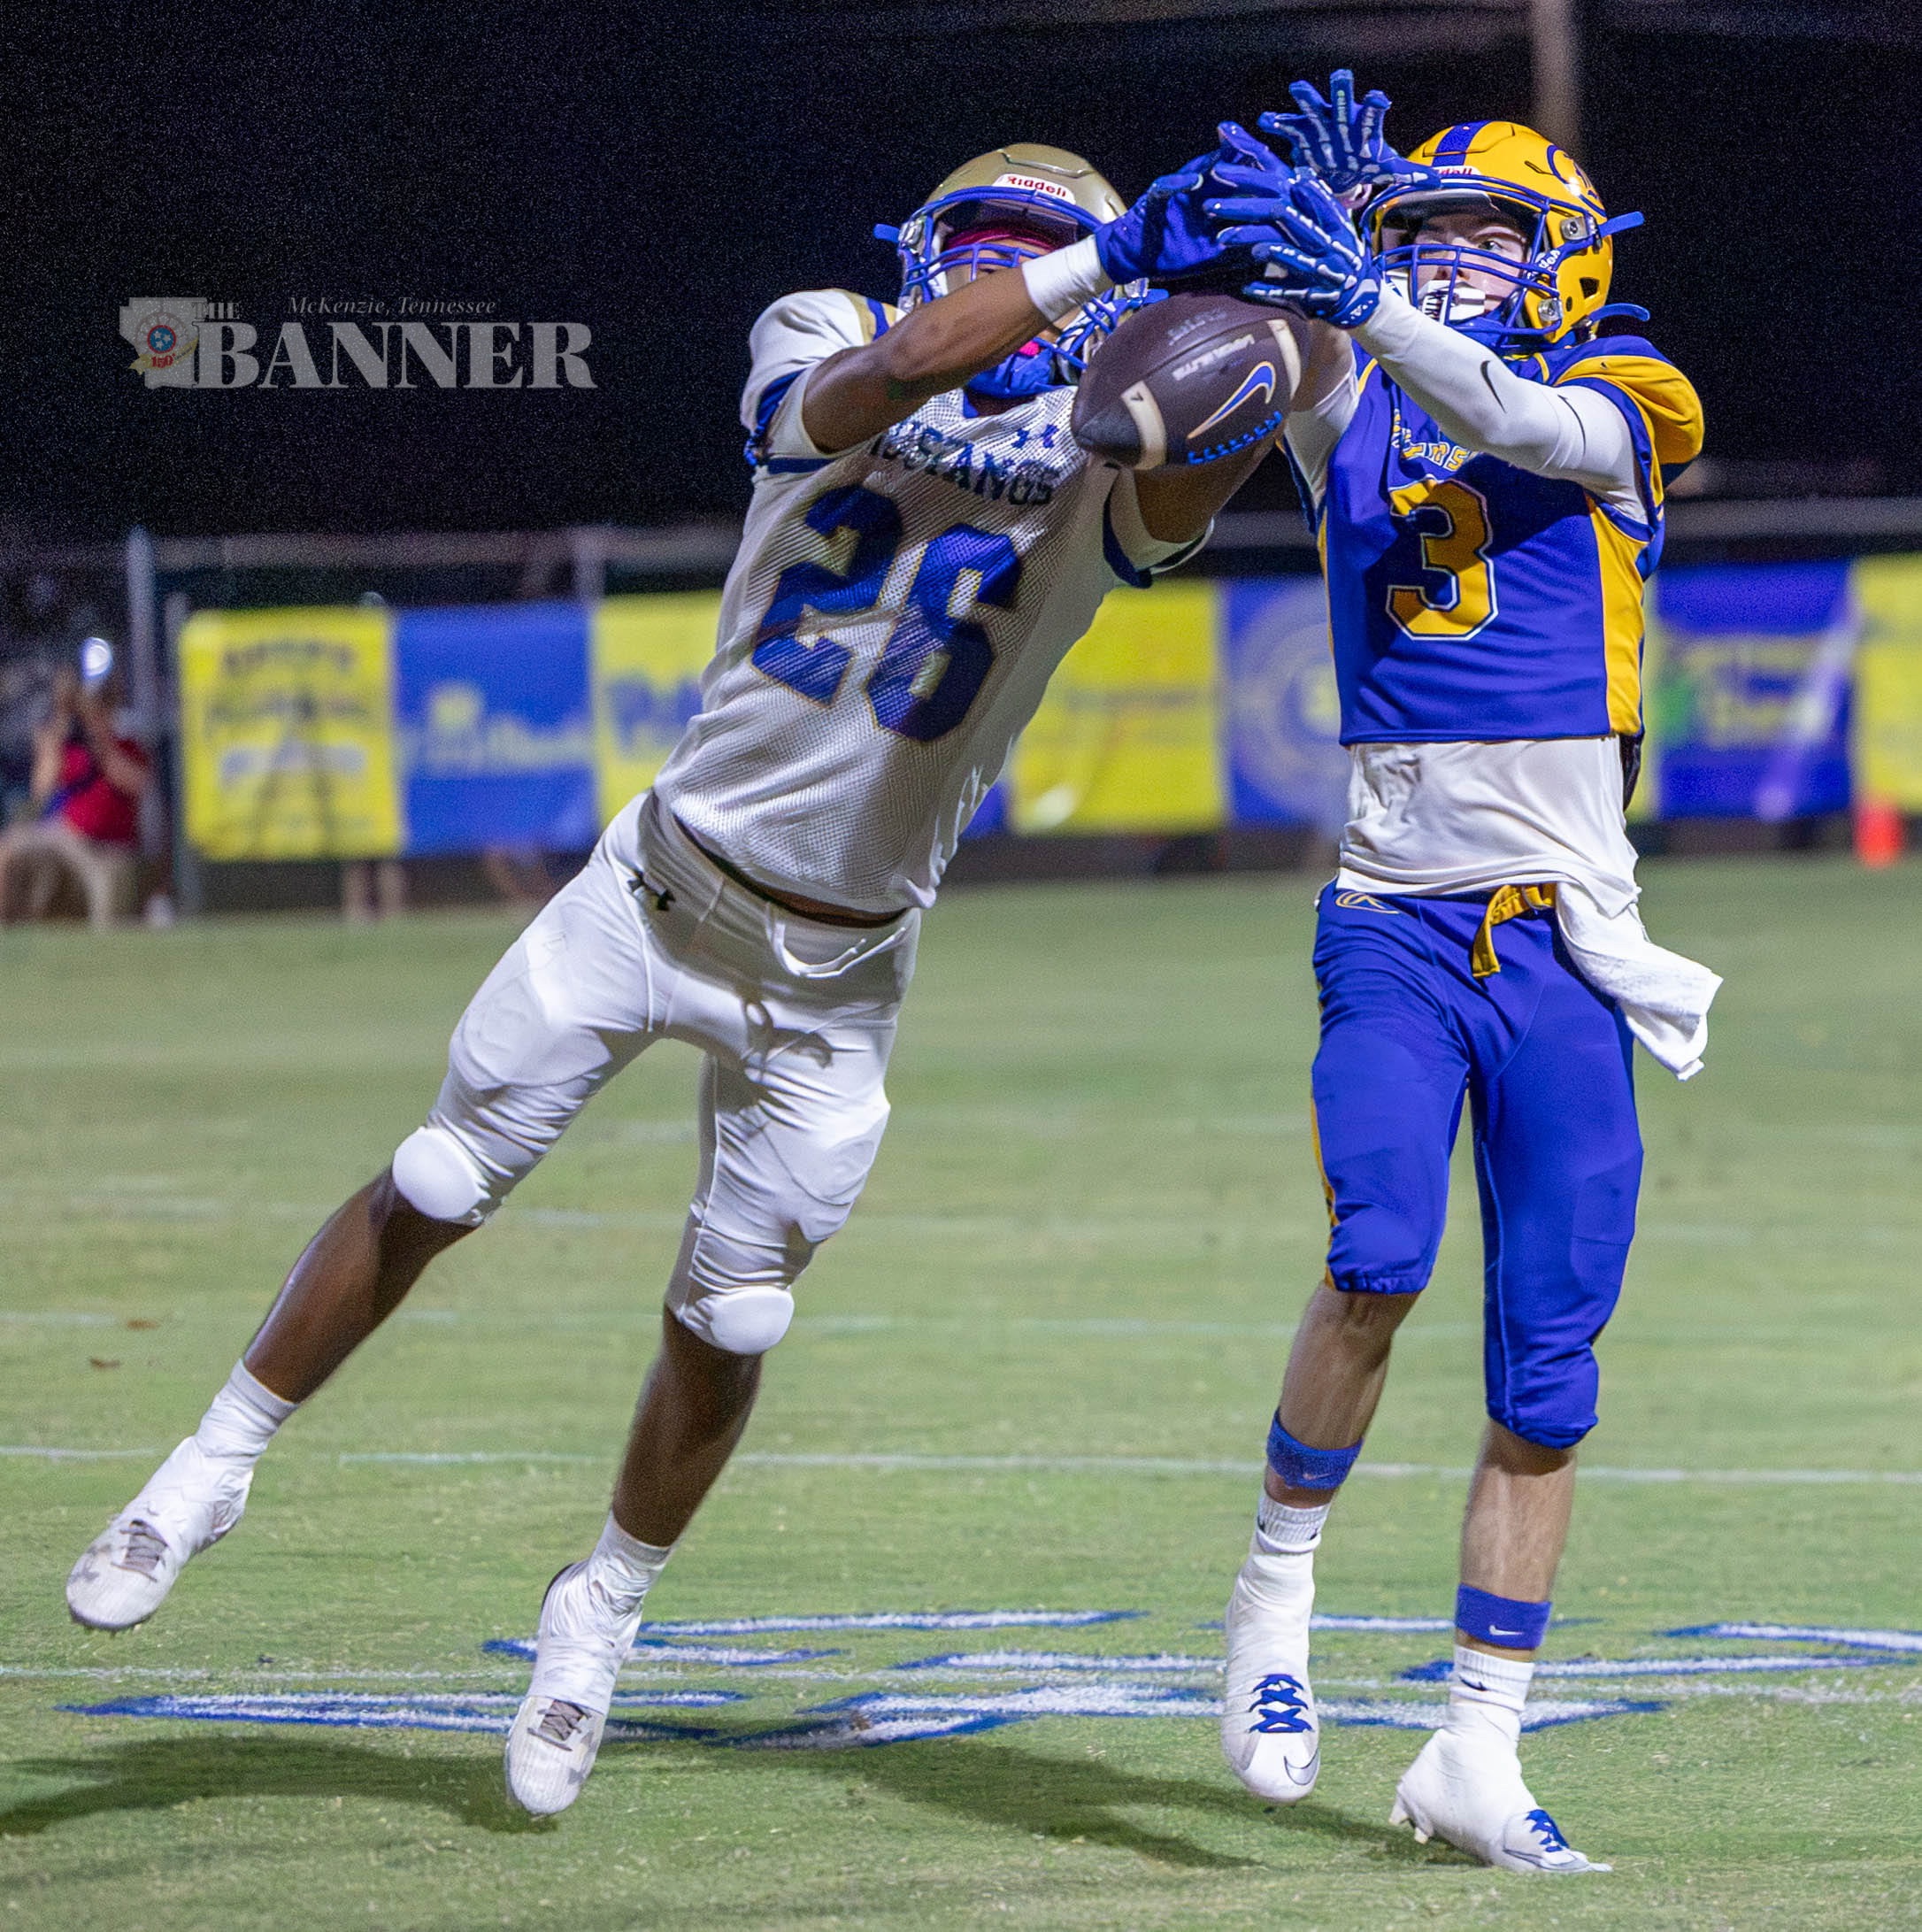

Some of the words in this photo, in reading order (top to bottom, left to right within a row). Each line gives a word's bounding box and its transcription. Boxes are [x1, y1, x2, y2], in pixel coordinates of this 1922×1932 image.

[1007, 175, 1067, 198] Riddell
[750, 483, 1023, 742] 26
[1385, 473, 1498, 641] 3
